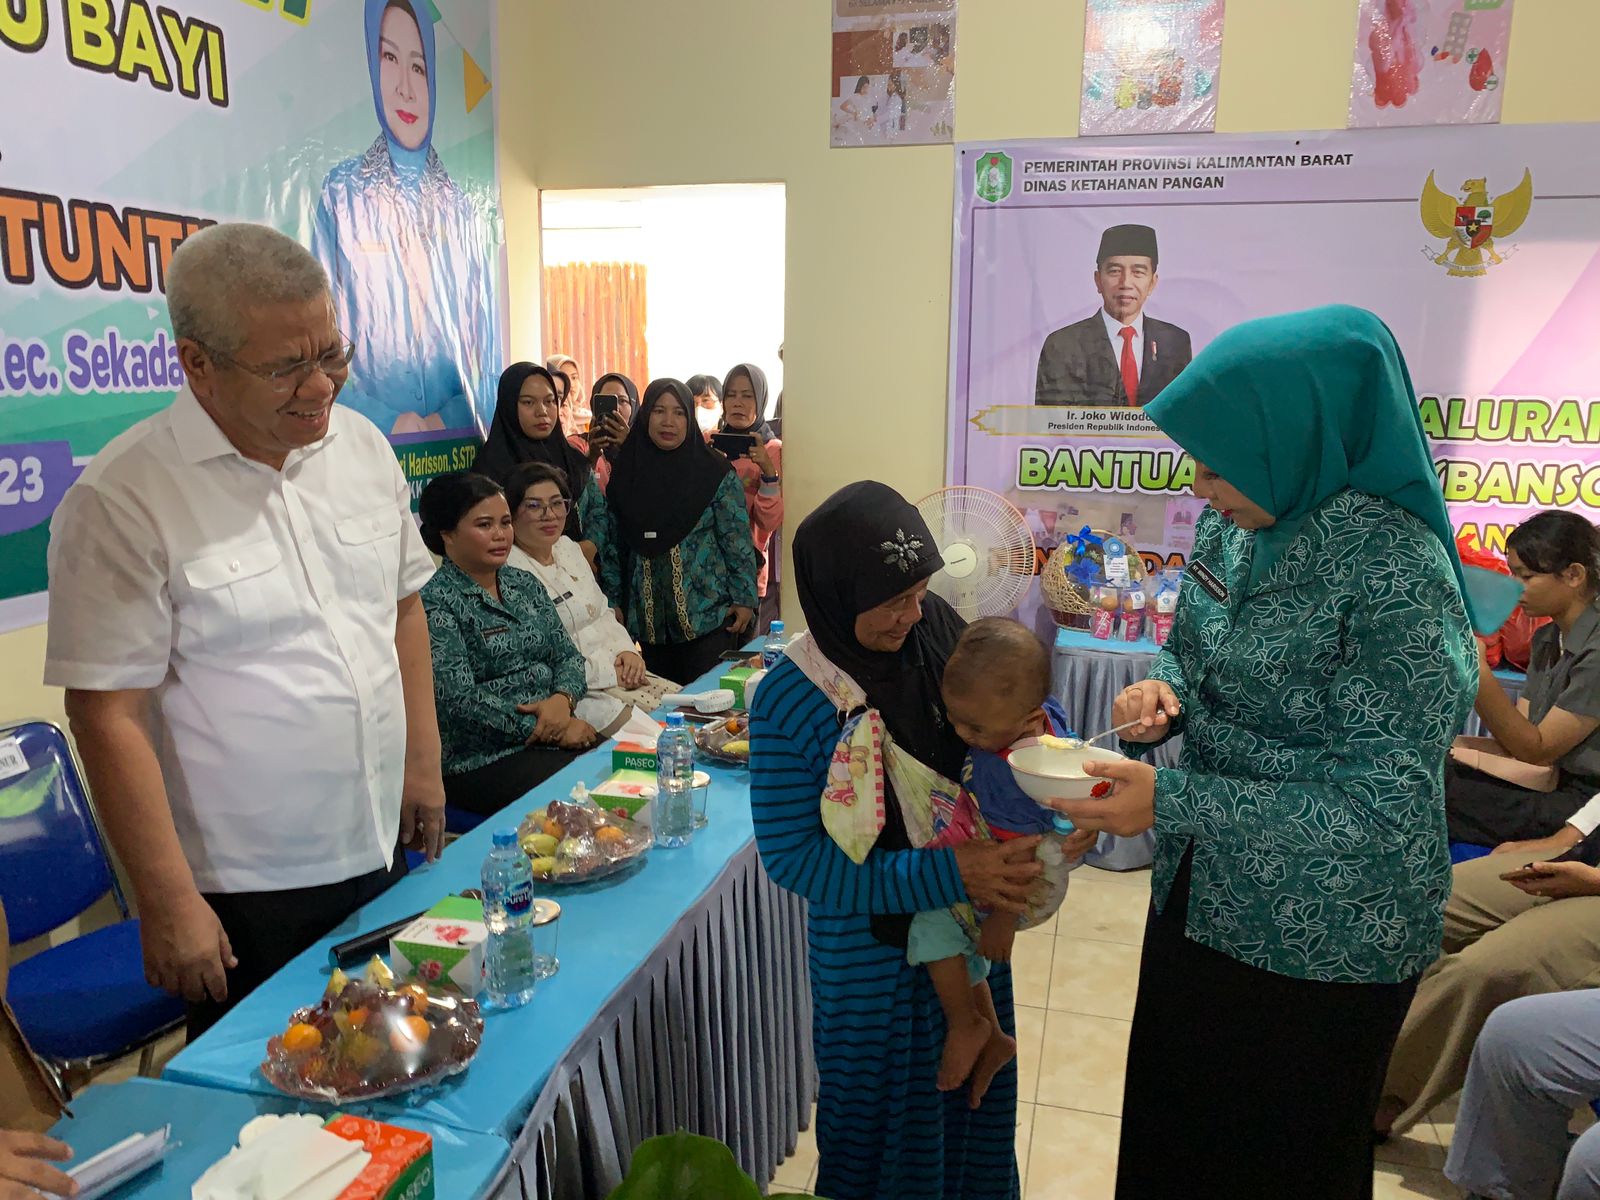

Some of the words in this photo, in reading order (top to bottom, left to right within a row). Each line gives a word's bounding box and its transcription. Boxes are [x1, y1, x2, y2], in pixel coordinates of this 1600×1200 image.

[62, 0, 229, 108] BAYI
[1024, 159, 1118, 174] PEMERINTAH
[1122, 156, 1192, 171] PROVINSI
[1196, 154, 1296, 169] KALIMANTAN
[1300, 153, 1354, 167] BARAT
[1023, 180, 1067, 193] DINAS
[1071, 177, 1158, 192] KETAHANAN
[1162, 176, 1225, 189] PANGAN
[0, 187, 218, 294] TUNT
[0, 342, 58, 391] ec.
[1066, 410, 1078, 420] Ir.
[1081, 410, 1106, 421] Joko
[1047, 422, 1085, 431] Presiden
[1086, 423, 1124, 432] Republik
[452, 445, 476, 470] S.STP
[625, 756, 655, 769] PASEO
